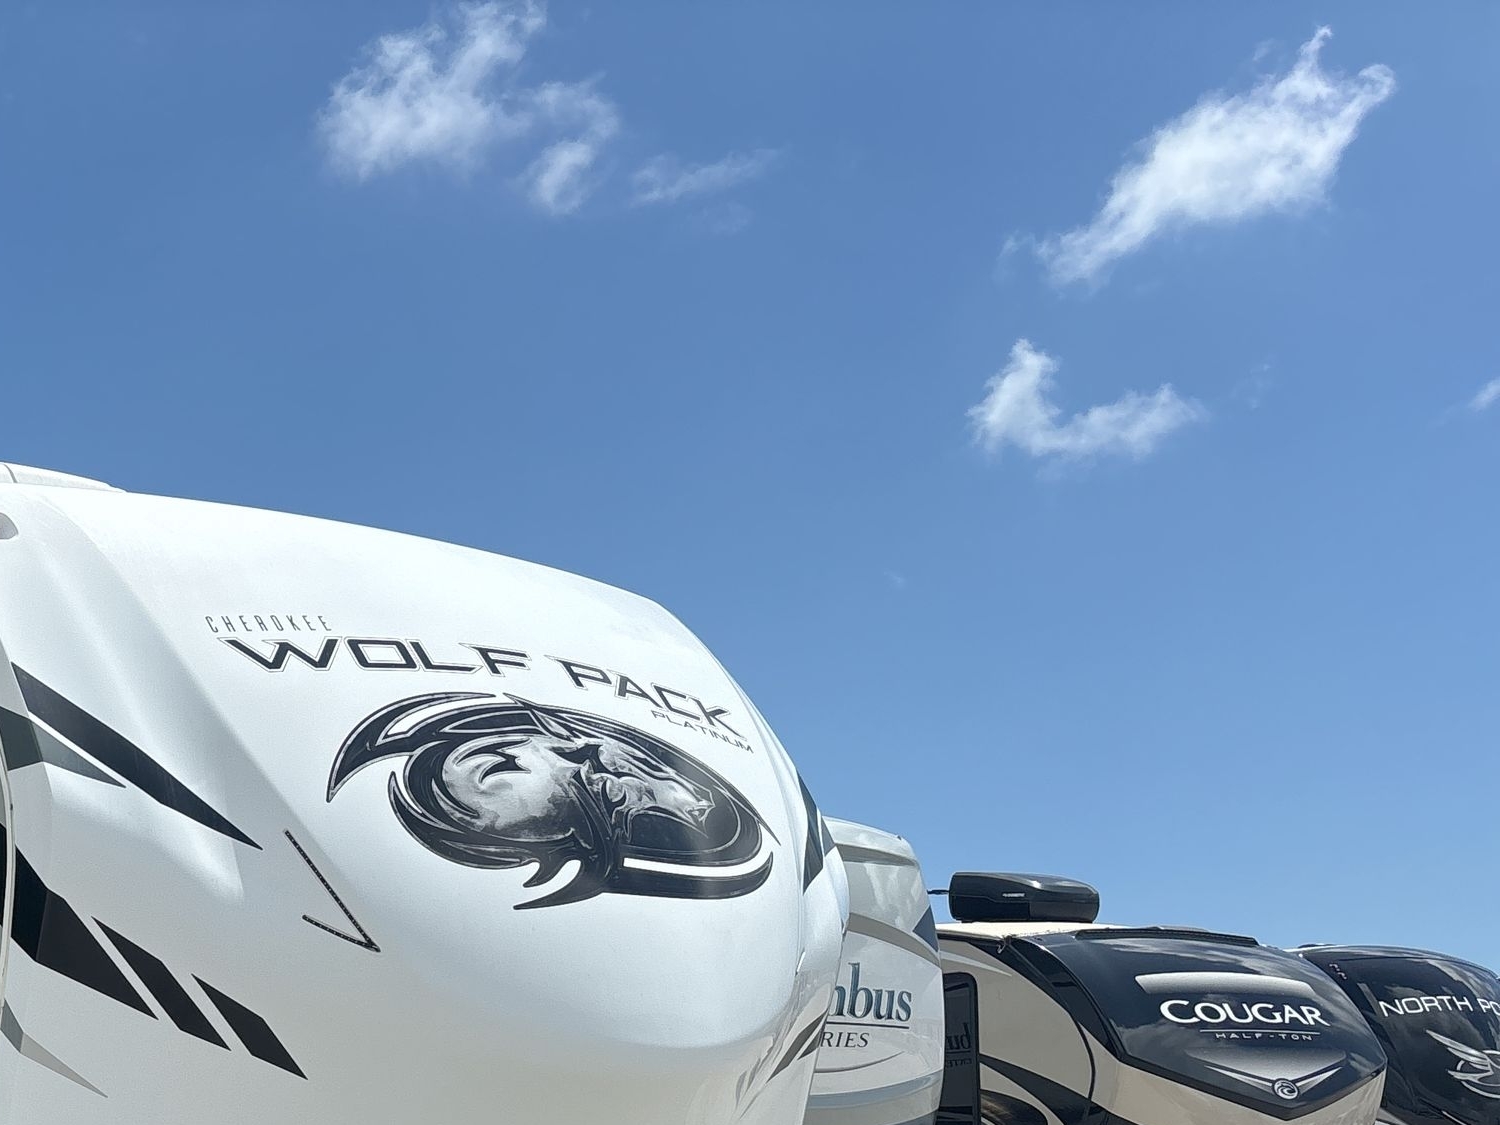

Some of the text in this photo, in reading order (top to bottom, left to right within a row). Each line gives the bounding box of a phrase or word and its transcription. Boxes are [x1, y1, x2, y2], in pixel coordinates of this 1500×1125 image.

[205, 615, 332, 633] CHEROKEE
[217, 636, 748, 742] WOLF PACK
[651, 710, 755, 754] PLATINUM
[1159, 999, 1332, 1026] COUGAR
[1379, 995, 1474, 1017] NORTH
[820, 1031, 870, 1048] RIES
